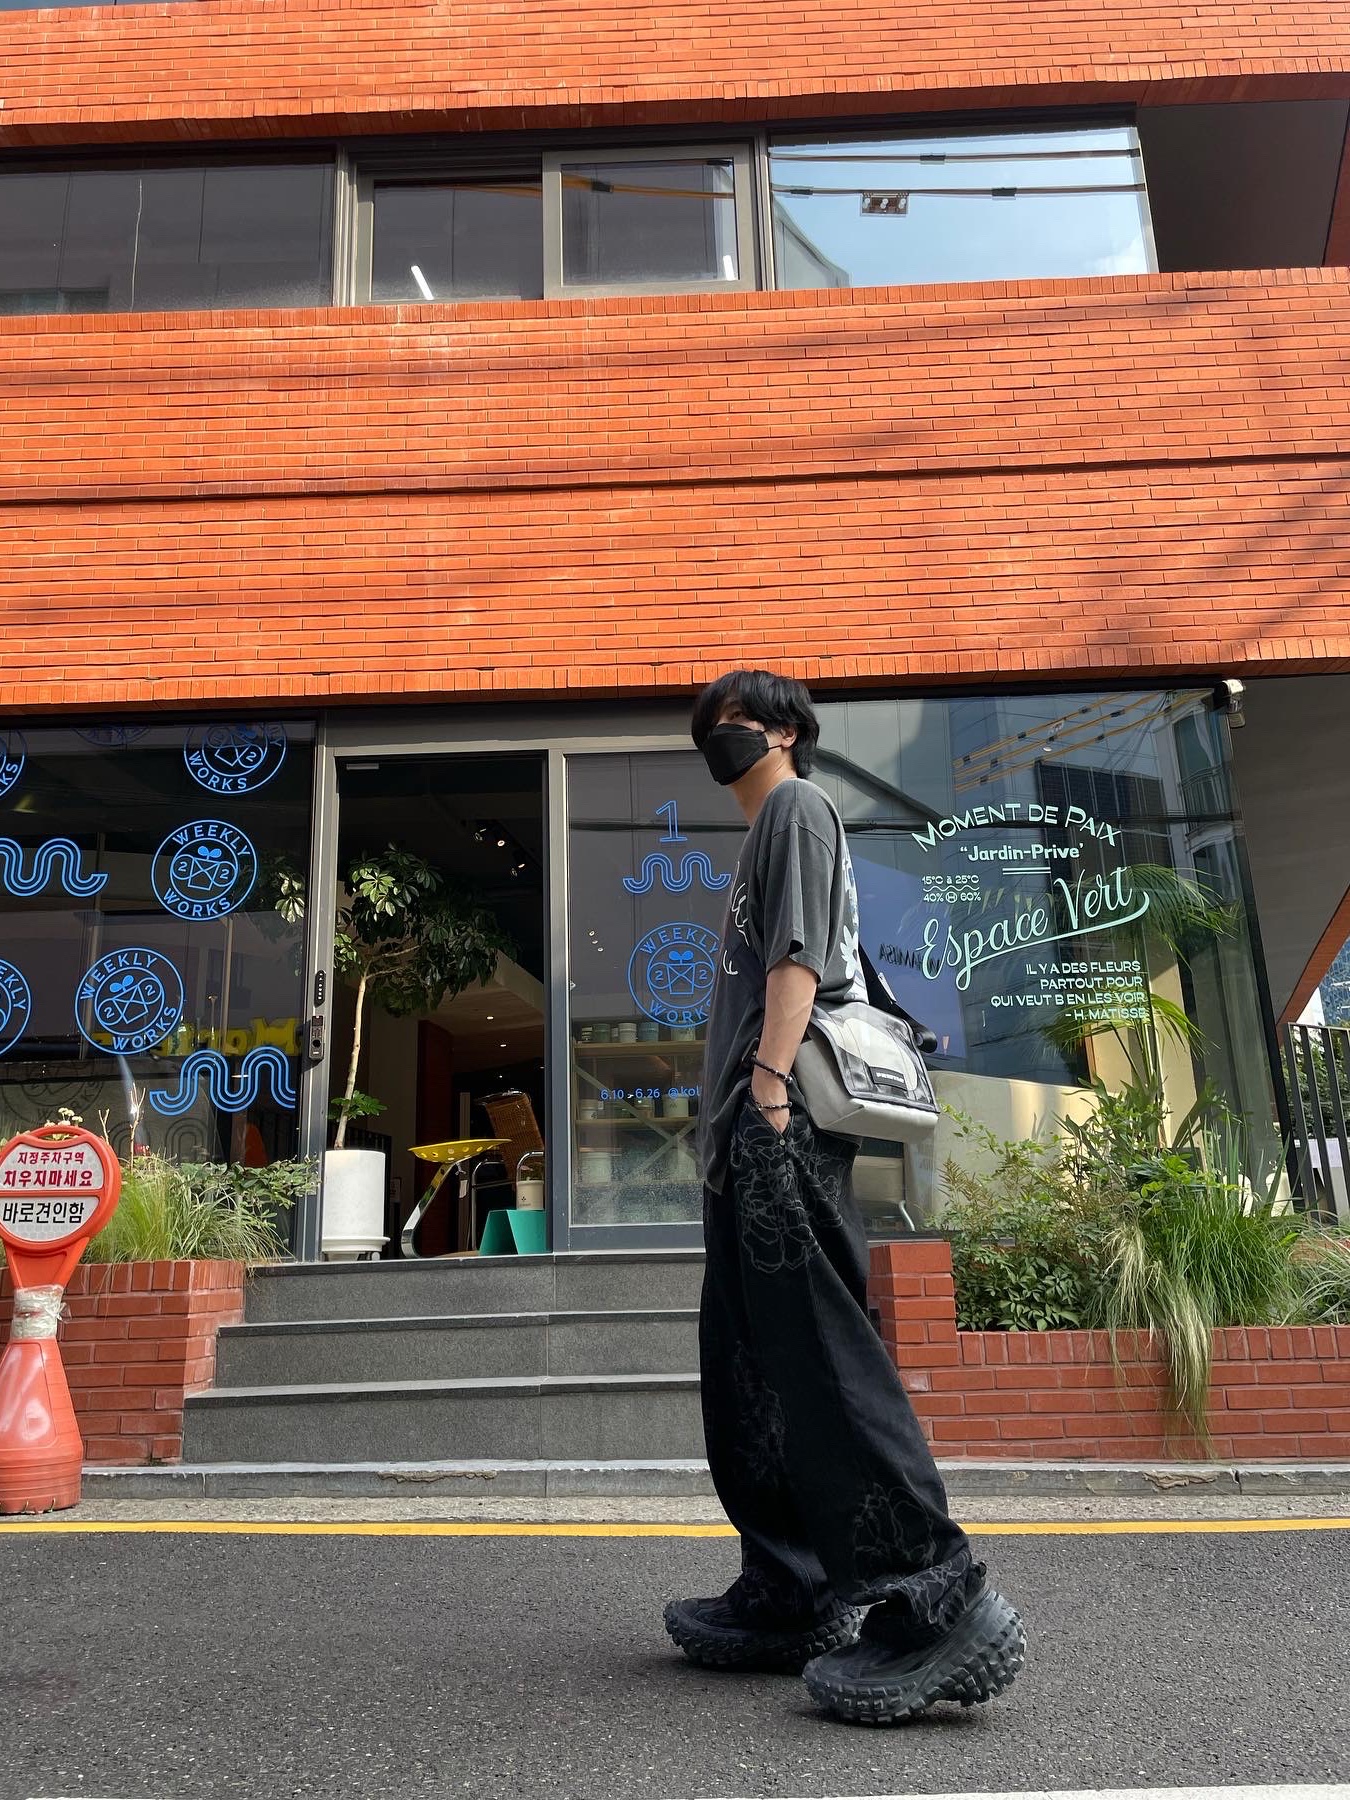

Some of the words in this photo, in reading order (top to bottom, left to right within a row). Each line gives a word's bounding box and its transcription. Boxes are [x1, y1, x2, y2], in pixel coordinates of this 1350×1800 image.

[189, 750, 247, 790] WORKS
[655, 800, 688, 842] 1
[911, 803, 1021, 852] MOMENT
[1028, 804, 1059, 825] DE
[1064, 805, 1121, 847] PAIX
[172, 825, 251, 856] WEEKLY
[955, 874, 980, 884] 25°C
[163, 887, 231, 917] WORKS
[923, 892, 944, 902] 40%
[960, 891, 981, 902] 60%
[640, 927, 719, 954] WEEKLY
[916, 908, 1048, 991] Espace
[1053, 866, 1133, 930] Vert
[80, 952, 157, 1000] WEEKLY
[1062, 961, 1088, 974] DES
[1091, 960, 1141, 973] FLEURS
[1040, 977, 1103, 990] PARTOUT
[1107, 976, 1143, 988] POUR
[991, 995, 1013, 1008] QUI
[1016, 995, 1052, 1006] VEUT
[1088, 993, 1112, 1004] LES
[1116, 992, 1145, 1004] VOIR
[112, 1007, 177, 1050] WORKS
[600, 1088, 624, 1100] 6.10
[635, 1088, 660, 1099] 6.26
[17, 1151, 85, 1165] 지정주차구역
[3, 1169, 93, 1187] 치우지마세요
[3, 1202, 85, 1224] 바로견인함
